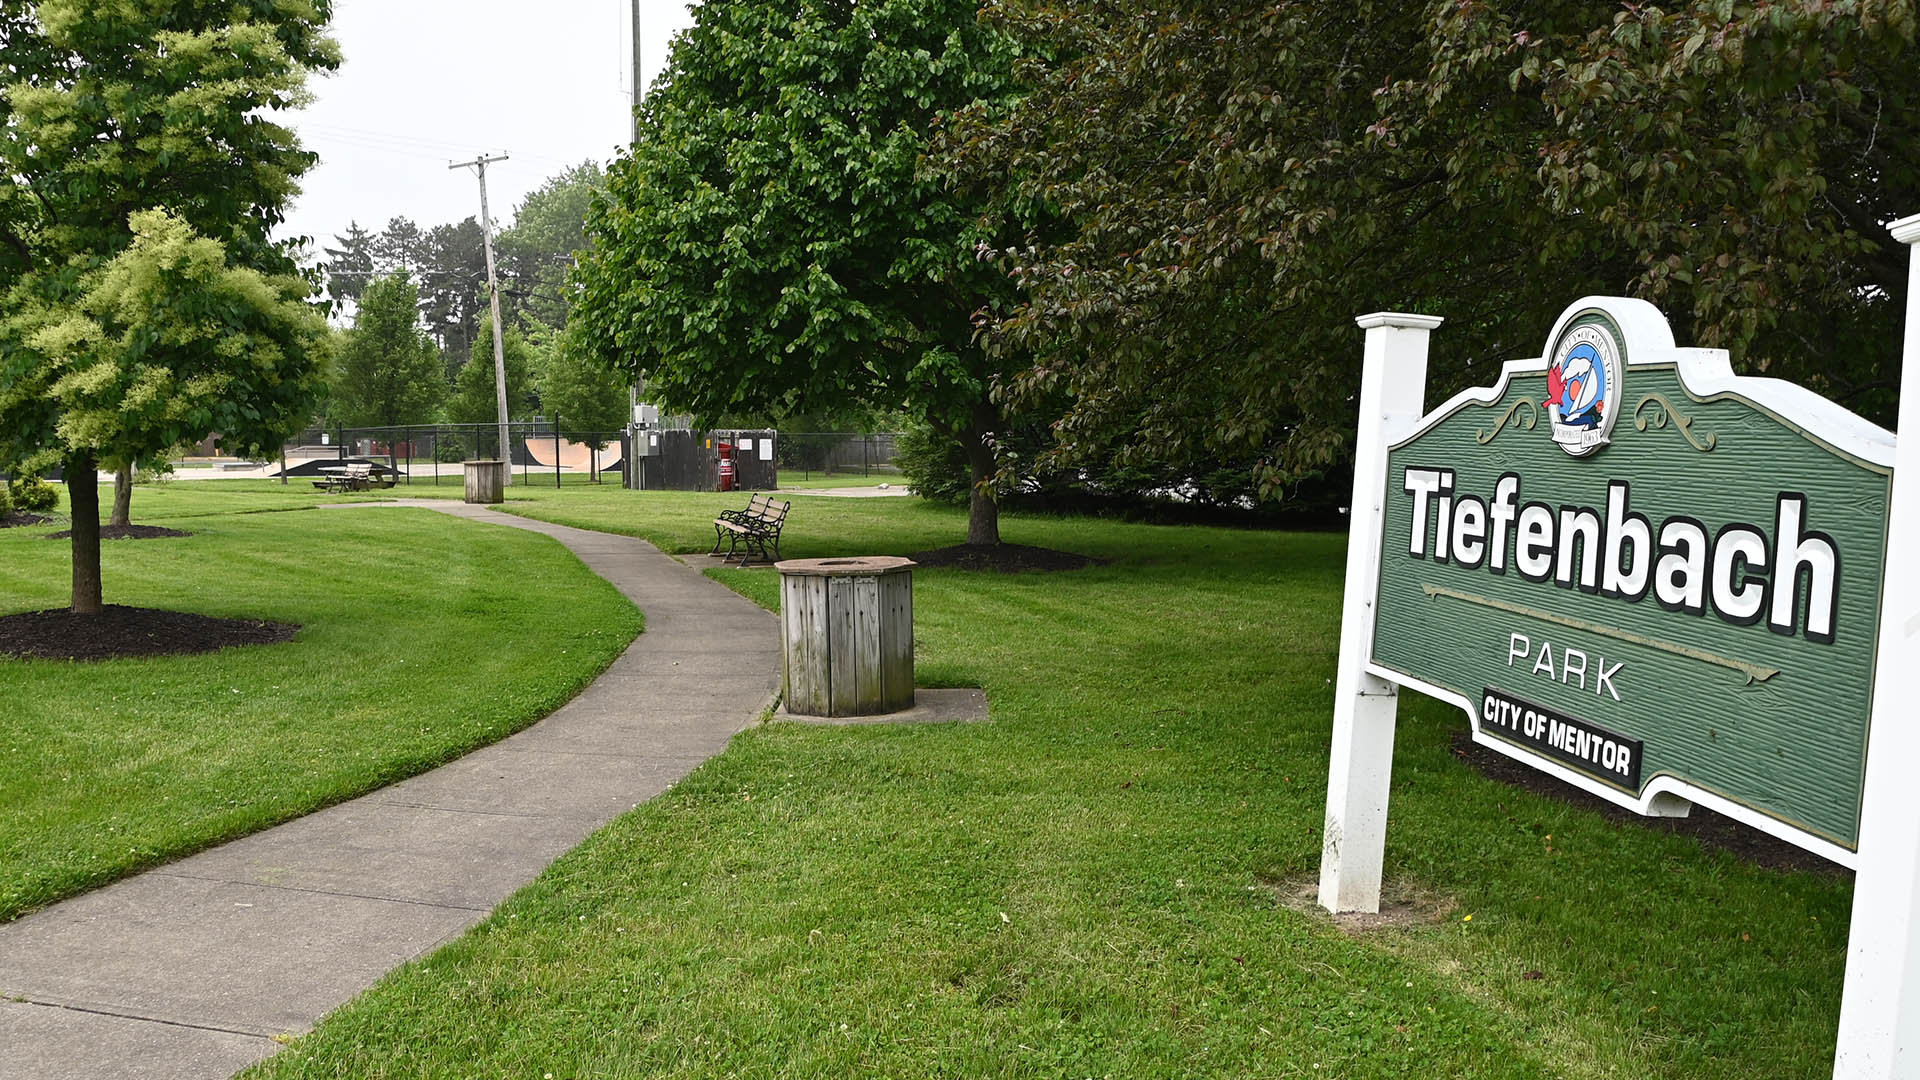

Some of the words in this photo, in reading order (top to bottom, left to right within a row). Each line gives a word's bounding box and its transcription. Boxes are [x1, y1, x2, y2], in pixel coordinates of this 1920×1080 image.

[1403, 466, 1838, 643] Tiefenbach
[1508, 632, 1625, 701] PARK
[1483, 695, 1522, 731] CITY
[1523, 710, 1547, 740] OF
[1548, 718, 1631, 776] MENTOR
